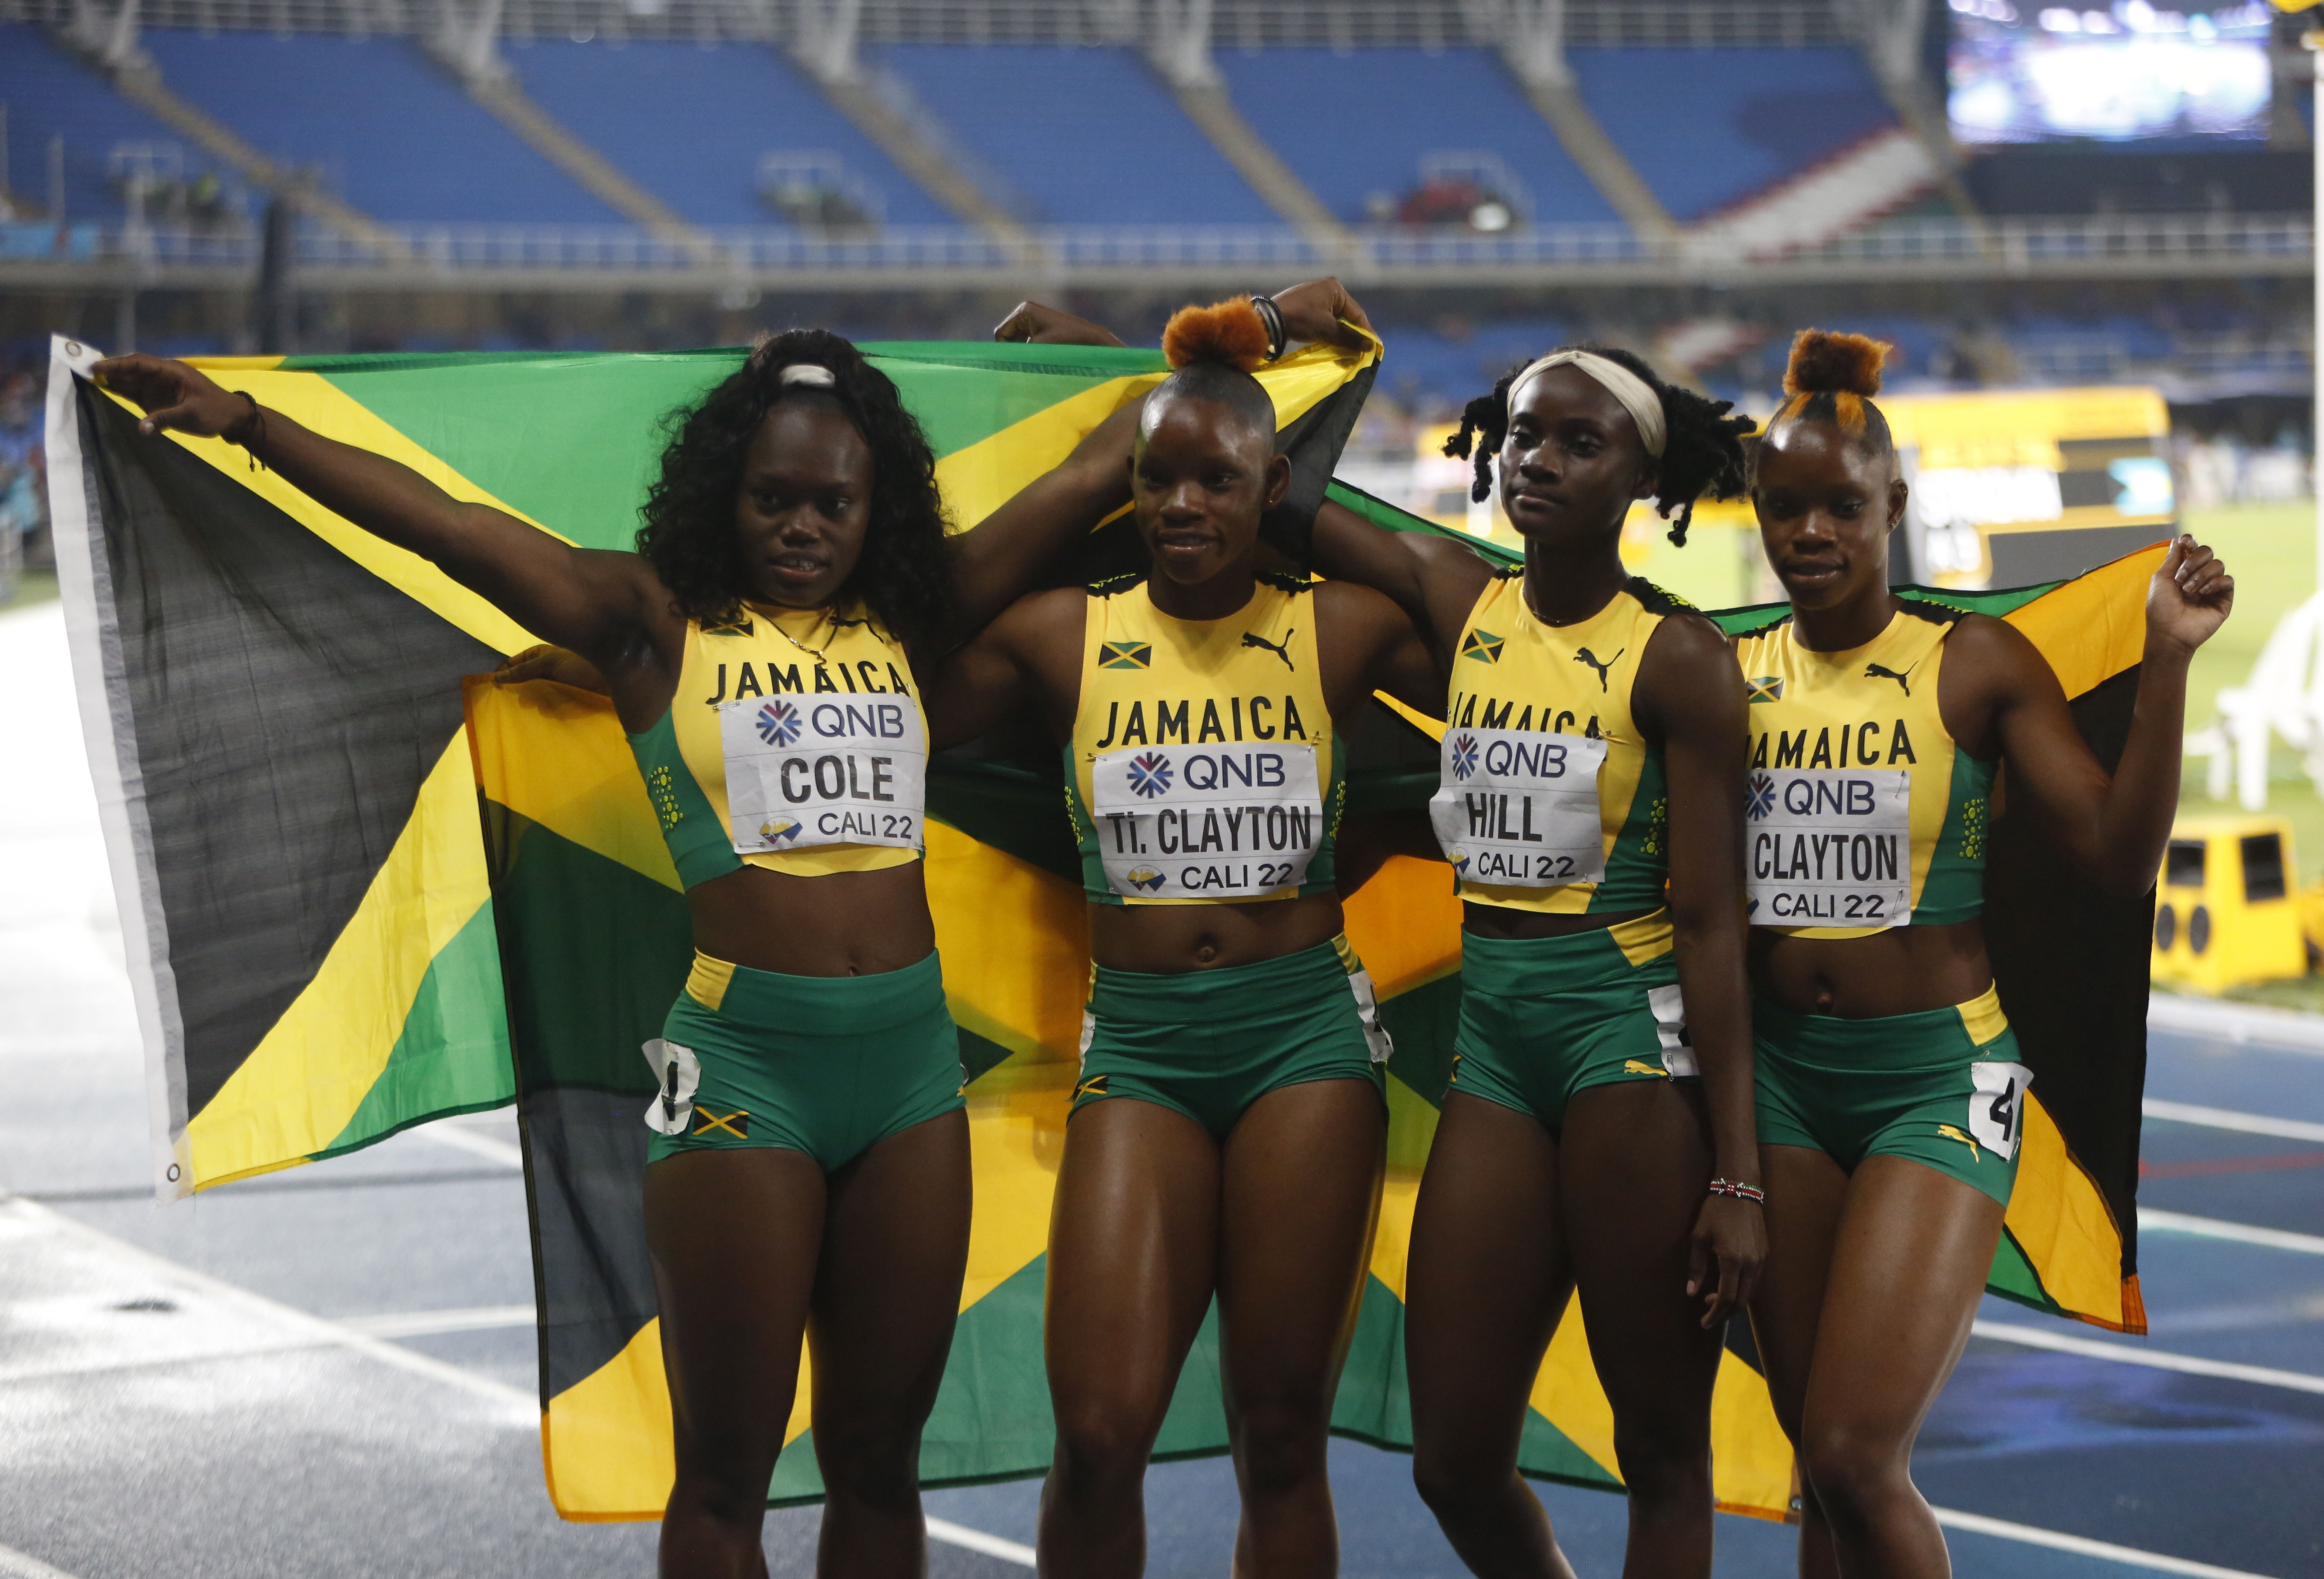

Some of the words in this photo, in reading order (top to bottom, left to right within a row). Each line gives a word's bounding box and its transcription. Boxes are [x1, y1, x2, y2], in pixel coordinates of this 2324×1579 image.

[705, 661, 912, 705] JAMAICA
[811, 704, 905, 739] QNB
[1096, 696, 1307, 749] JAMAICA
[1486, 740, 1568, 778] QNB
[1746, 719, 1917, 770] AMAICA
[781, 755, 895, 804] COLE
[1184, 753, 1286, 790] QNB
[1465, 793, 1543, 842] HILL
[1784, 779, 1876, 816] QNB
[818, 811, 876, 836] CALI
[882, 815, 913, 839] 22
[1106, 811, 1146, 854] Ti.
[1158, 806, 1311, 855] CLAYTON
[1181, 865, 1249, 889] CALI
[1258, 863, 1294, 886] 22
[1478, 852, 1529, 878] CALI
[1536, 856, 1576, 879] 22
[1754, 833, 1897, 881] CLAYTON
[1772, 893, 1835, 918] CALI
[1843, 894, 1884, 919] 22
[1989, 1076, 2015, 1142] 4
